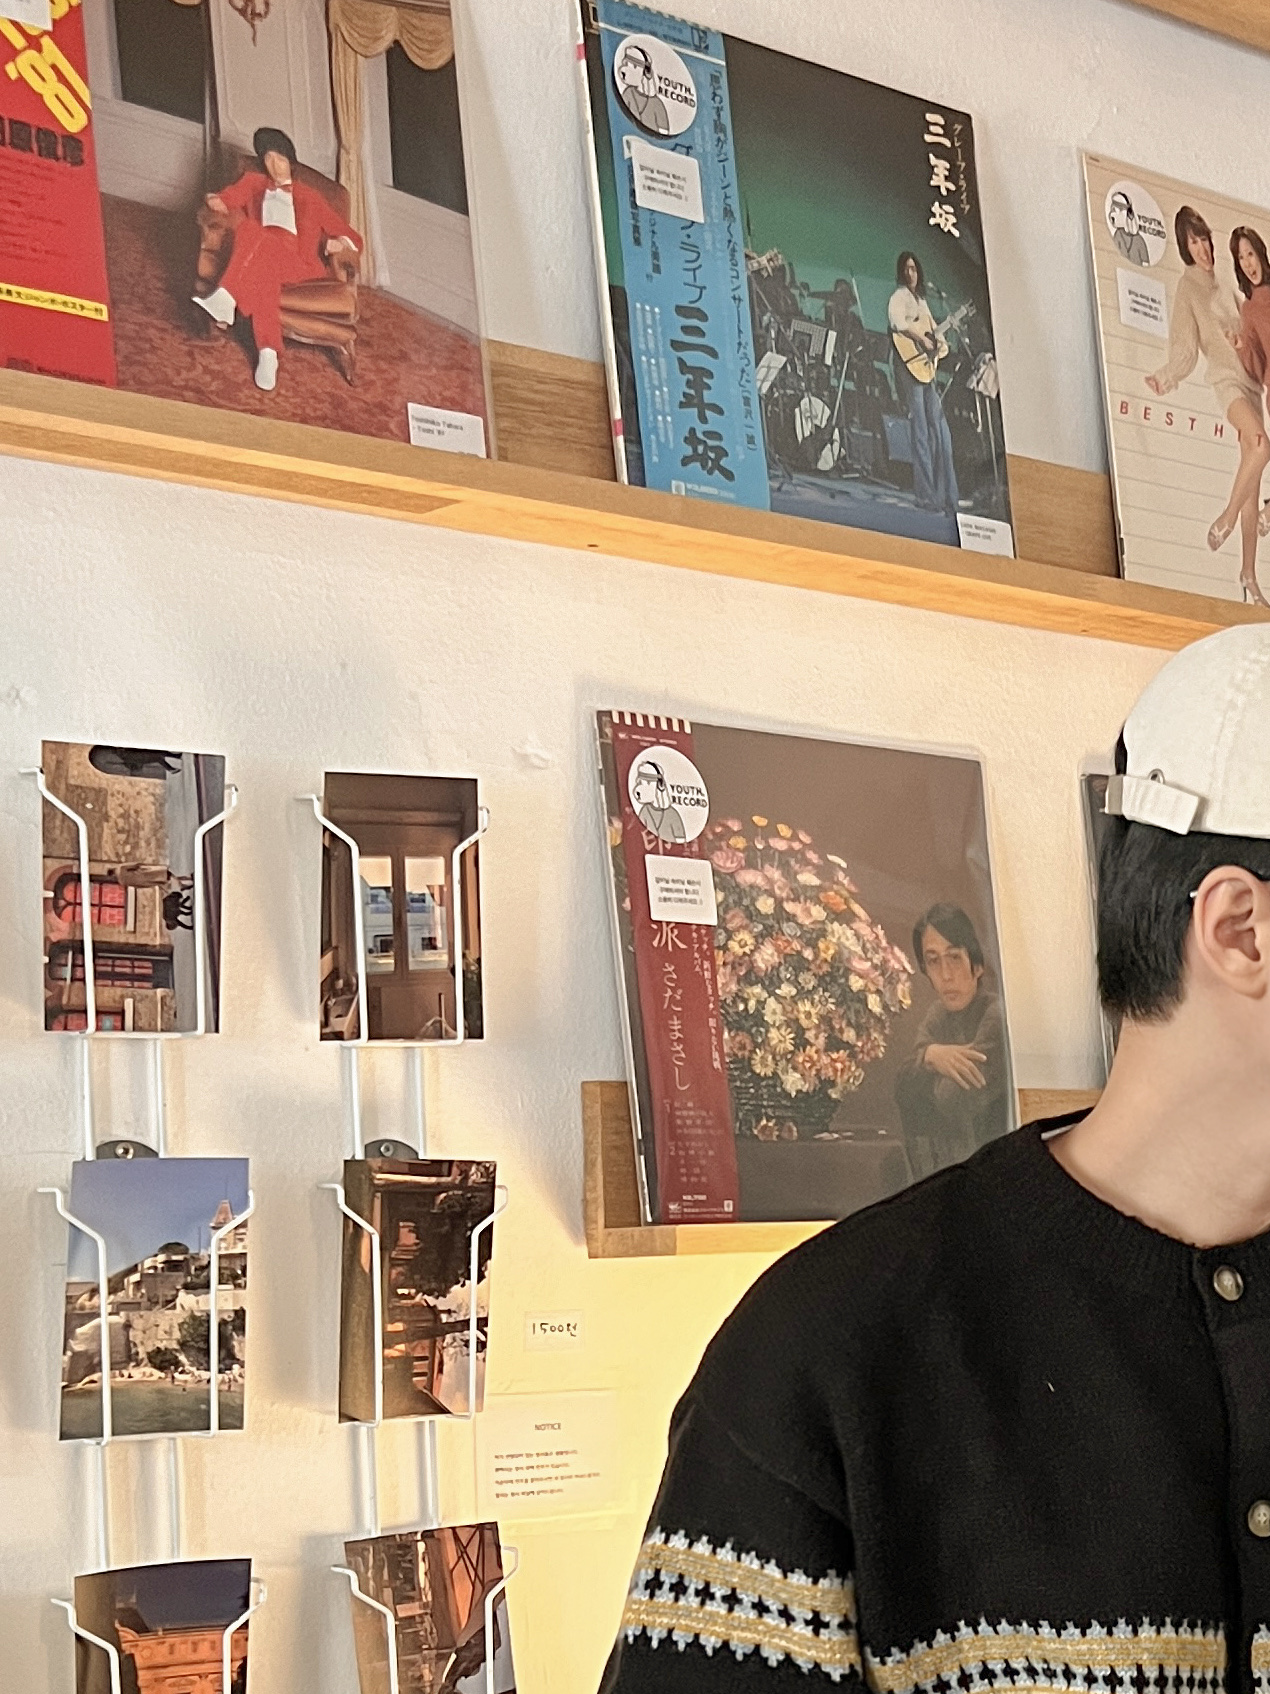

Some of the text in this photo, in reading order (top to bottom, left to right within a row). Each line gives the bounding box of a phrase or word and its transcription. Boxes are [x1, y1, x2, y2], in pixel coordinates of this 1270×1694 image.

[657, 74, 695, 96] YOUTH.
[657, 87, 696, 109] RECORD
[923, 112, 960, 238] 三年坂
[1138, 223, 1167, 240] RECORD
[669, 303, 736, 482] 三年坂
[1119, 401, 1197, 431] BEST
[669, 783, 705, 797] YOUTH.
[671, 795, 708, 809] RECORD
[661, 962, 692, 1091] さだまさし
[531, 1322, 578, 1338] 1500원
[534, 1422, 562, 1431] NOTICE
